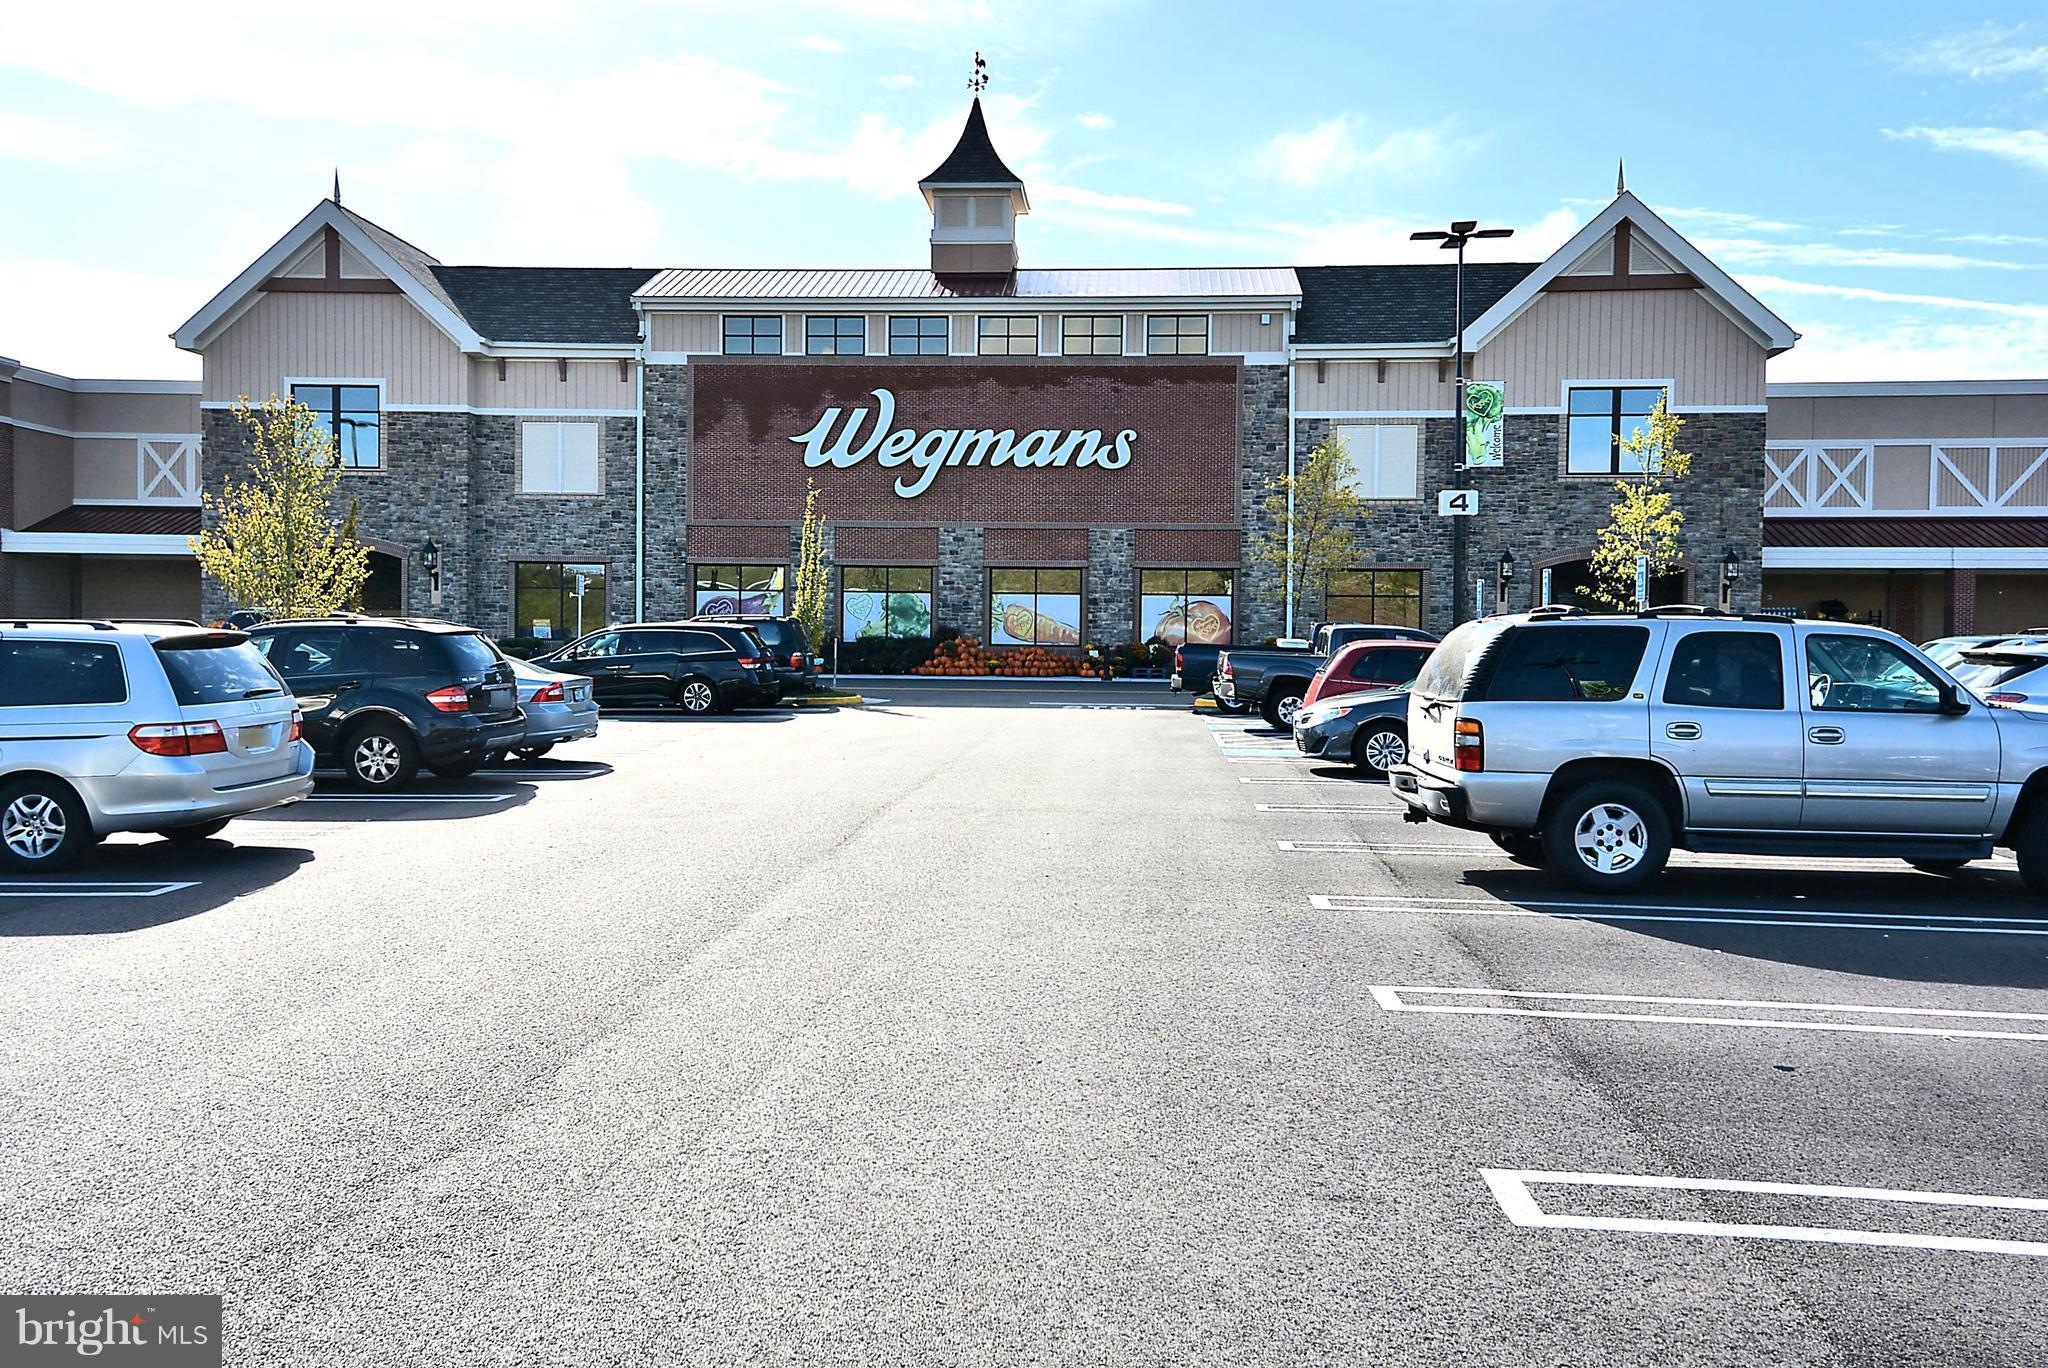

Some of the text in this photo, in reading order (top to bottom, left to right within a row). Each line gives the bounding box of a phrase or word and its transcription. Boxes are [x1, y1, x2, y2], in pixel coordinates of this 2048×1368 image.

[788, 388, 1138, 498] Wegmans
[1489, 424, 1502, 461] Welcome
[1449, 493, 1469, 512] 4
